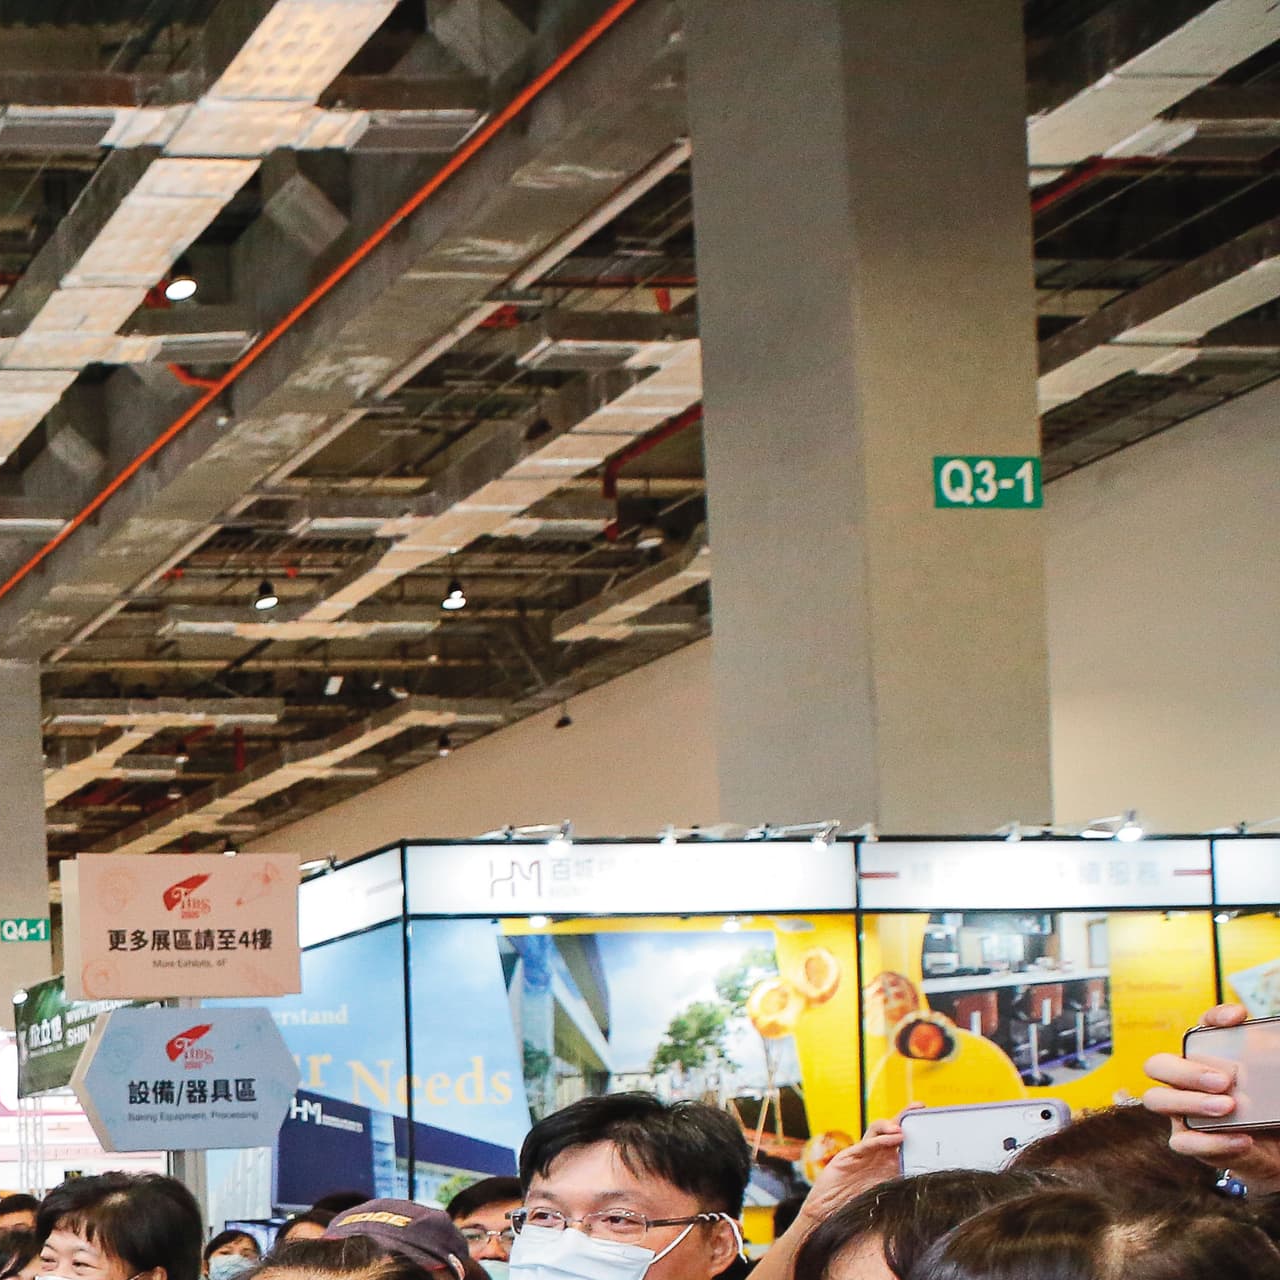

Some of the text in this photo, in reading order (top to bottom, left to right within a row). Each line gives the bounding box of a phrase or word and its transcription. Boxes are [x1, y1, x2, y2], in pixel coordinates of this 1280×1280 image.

[939, 460, 1035, 506] Q3-1
[1, 920, 48, 942] Q4-1
[107, 928, 274, 952] 更多展區請至4樓
[127, 1077, 258, 1106] 設備/器具區
[345, 1055, 514, 1107] Needs
